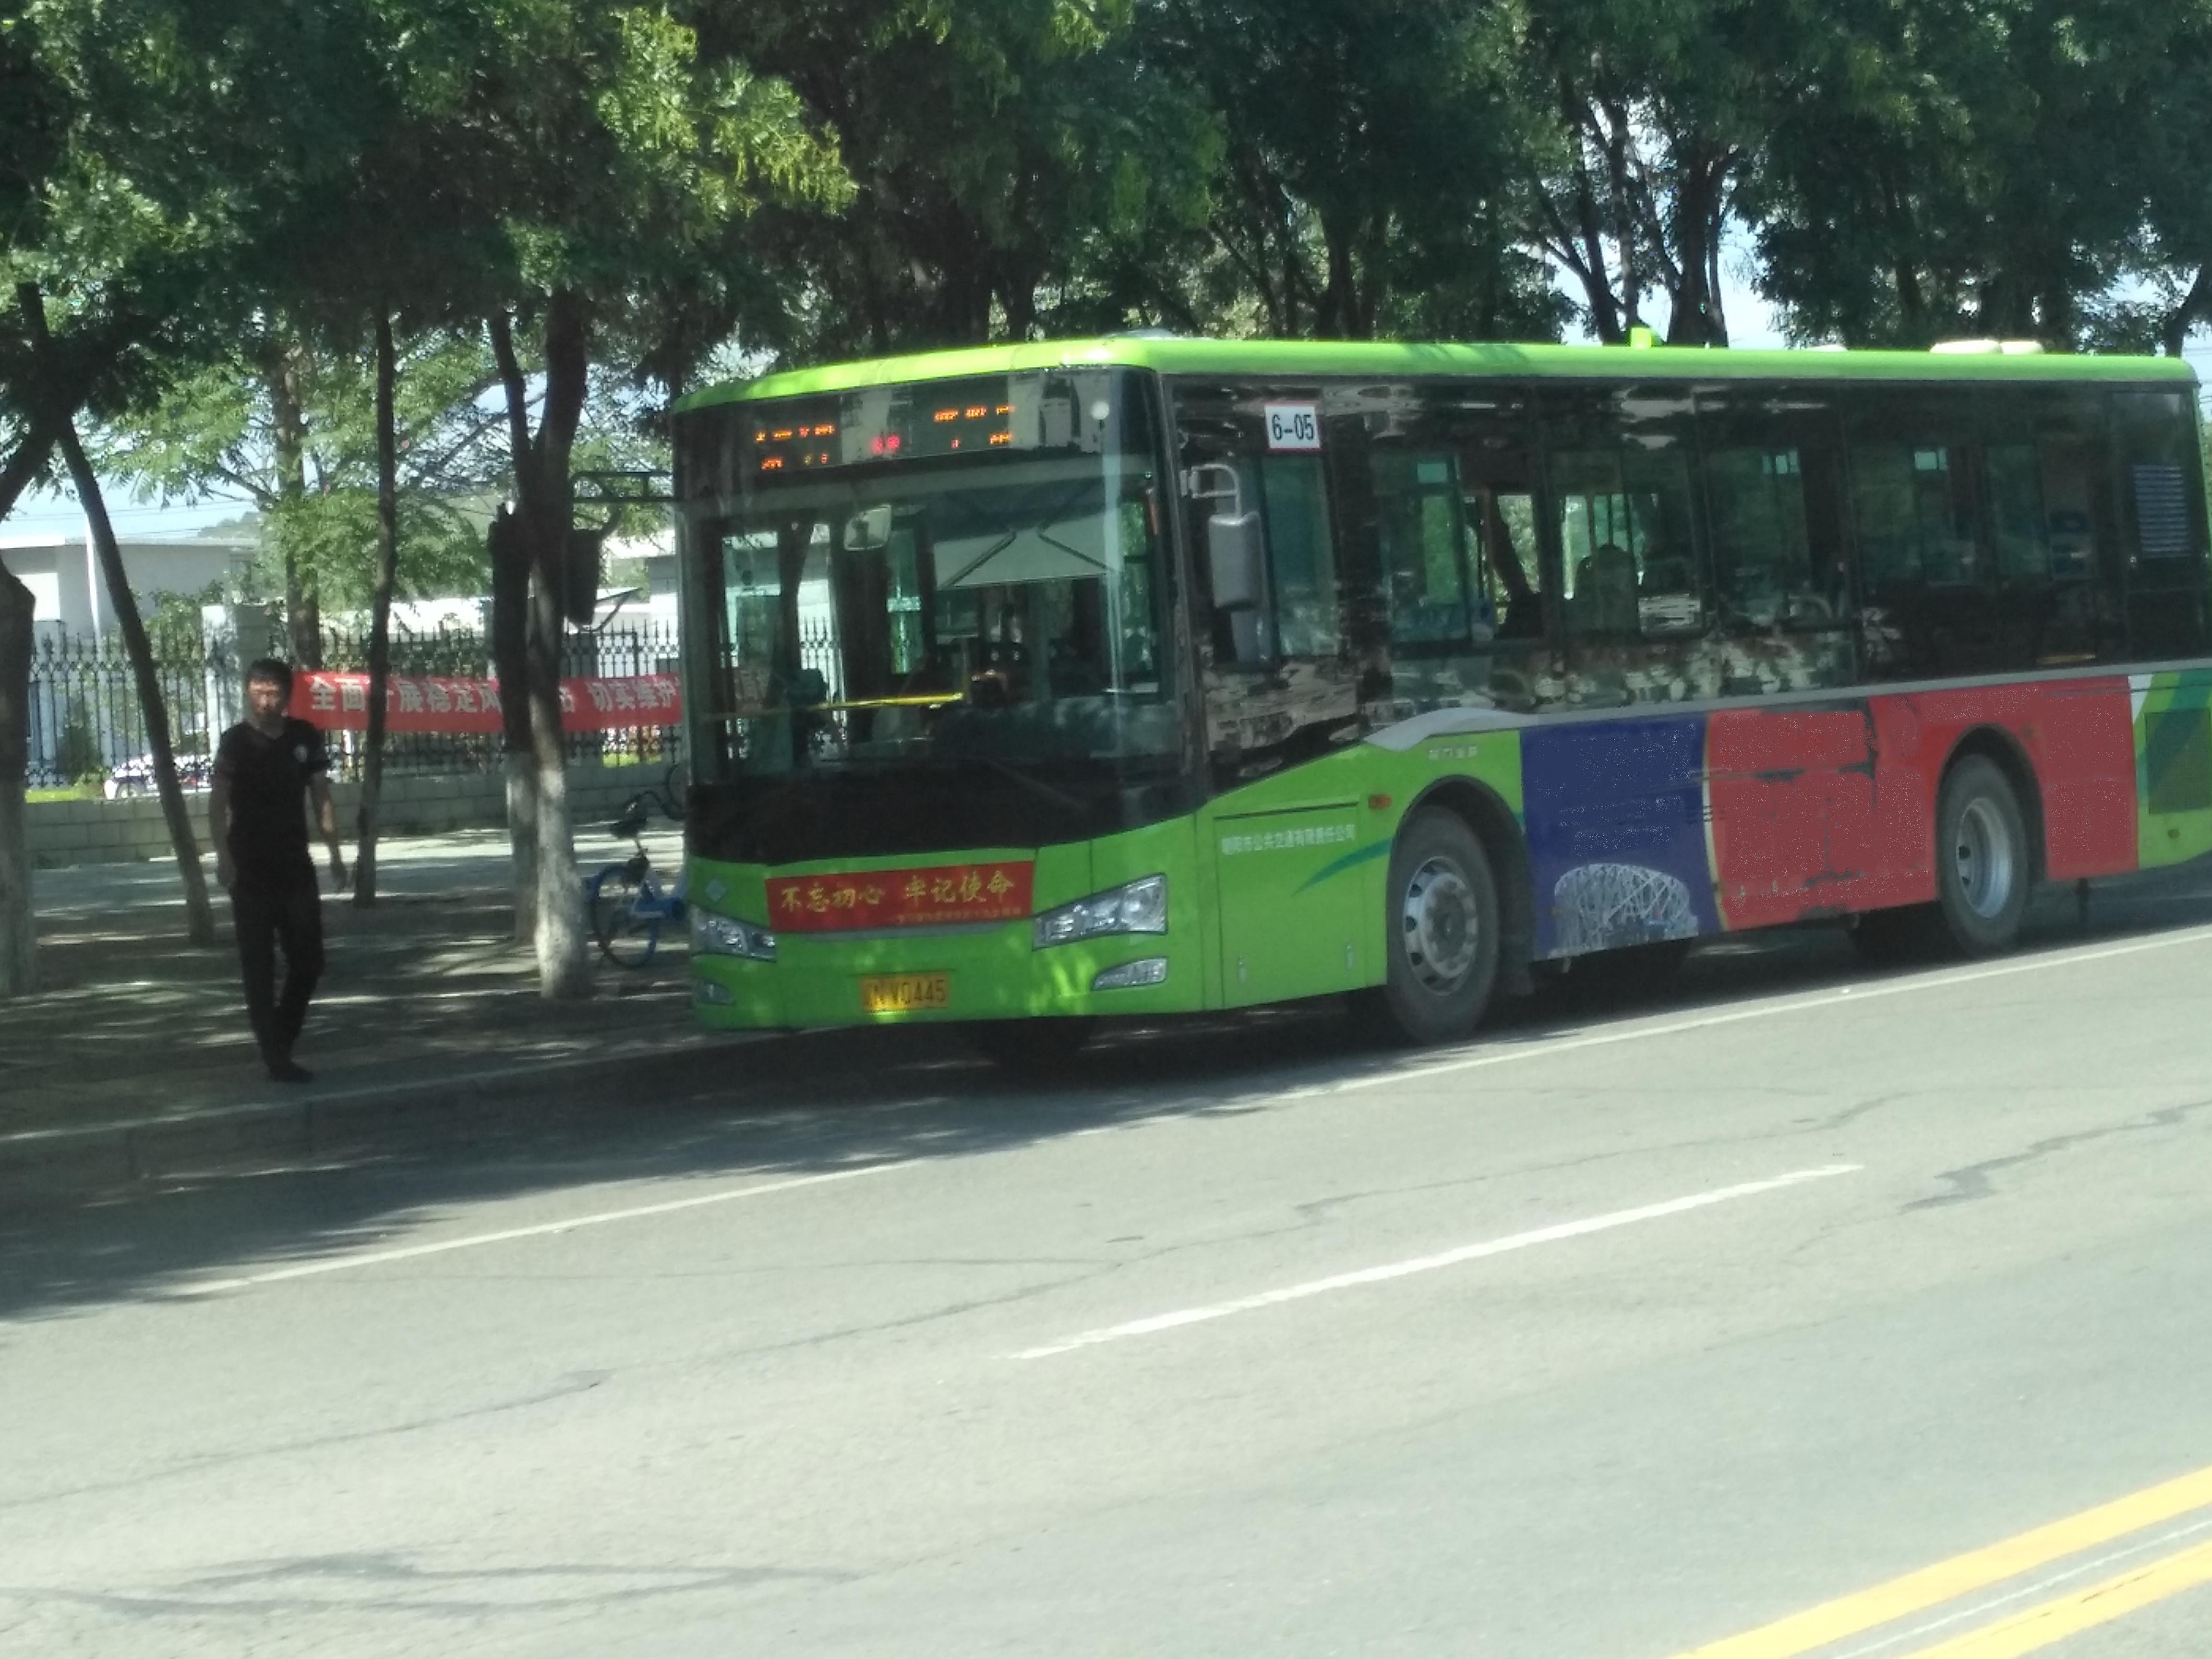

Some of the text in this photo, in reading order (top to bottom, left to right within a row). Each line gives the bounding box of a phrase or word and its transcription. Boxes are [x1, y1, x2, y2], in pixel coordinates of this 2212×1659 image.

[1272, 414, 1314, 440] 6-05
[781, 870, 1014, 913] 不忘初心 牢记使命
